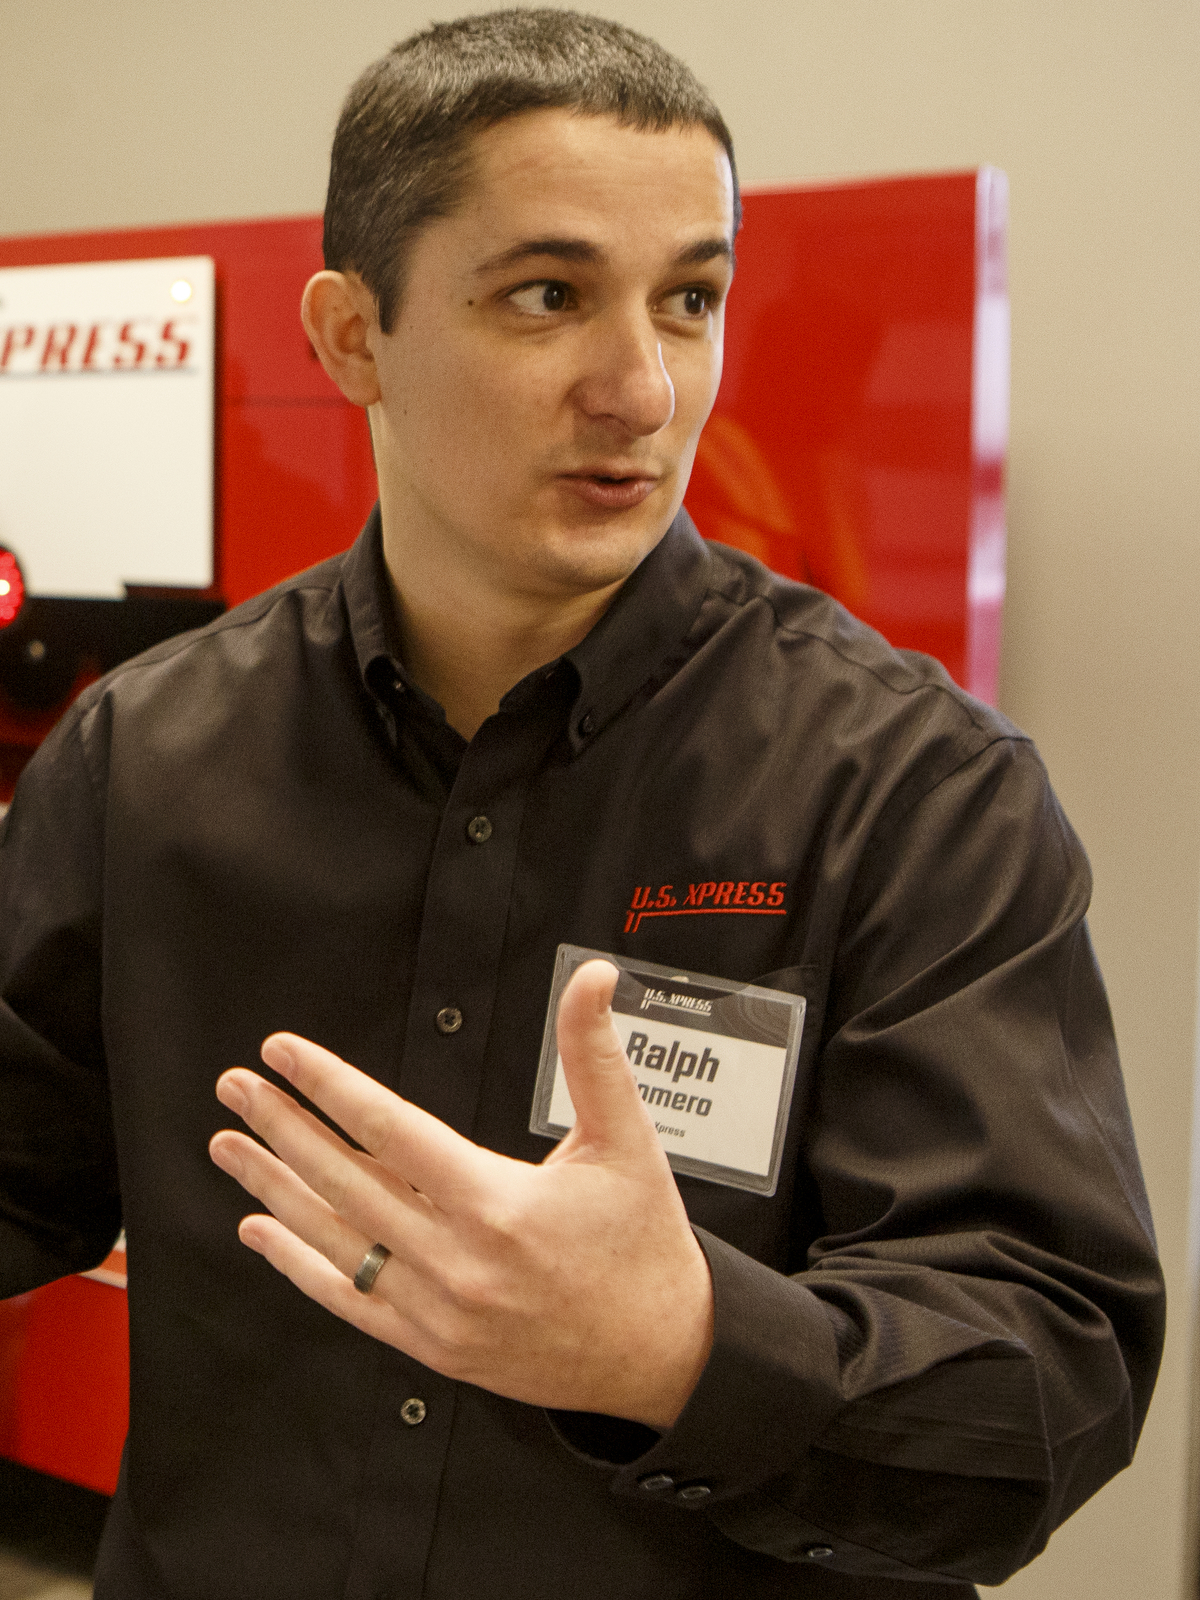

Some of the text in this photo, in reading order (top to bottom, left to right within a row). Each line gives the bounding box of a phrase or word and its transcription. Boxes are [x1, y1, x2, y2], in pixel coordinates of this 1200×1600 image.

[630, 881, 787, 909] U.S. XPRESS
[643, 988, 712, 1012] U.S. XPRESS
[626, 1031, 720, 1083] Ralph
[634, 1075, 713, 1117] omero
